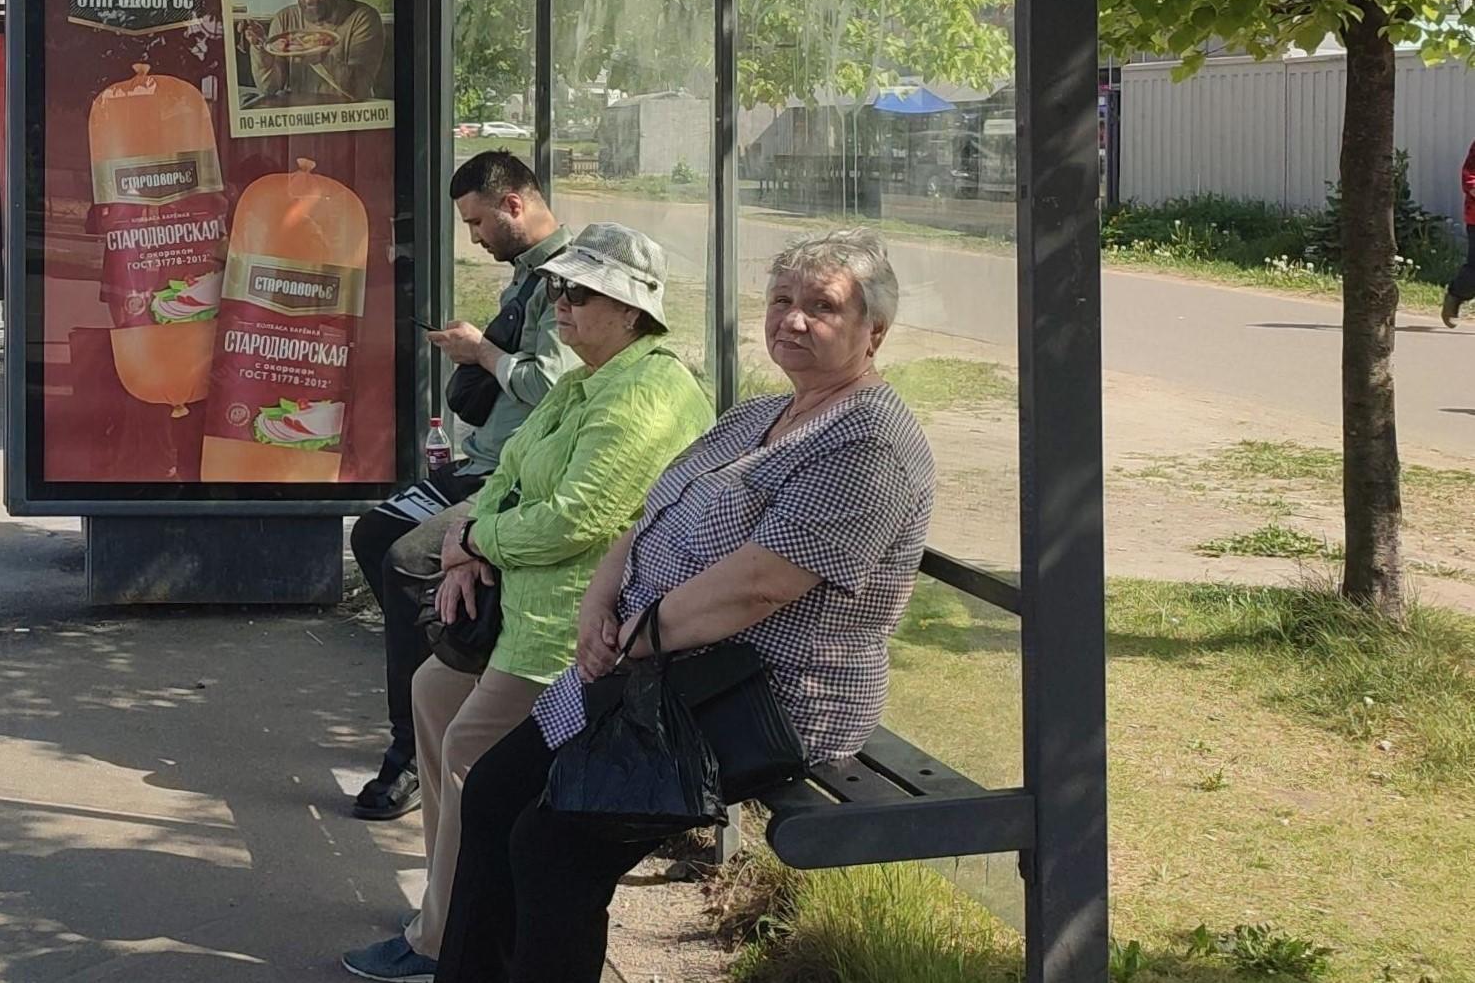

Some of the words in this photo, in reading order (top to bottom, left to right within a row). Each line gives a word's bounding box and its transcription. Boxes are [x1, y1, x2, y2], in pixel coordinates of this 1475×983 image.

[239, 110, 338, 130] ПО-НАСТОЯЩЕМУ
[341, 107, 390, 123] ВКУСНО!
[107, 220, 220, 250] СТАРОДВОРСКАЯ
[127, 259, 153, 271] ГОСТ
[224, 330, 348, 367] СТАРОДВОРСКАЯ
[239, 368, 269, 381] ГОСТ
